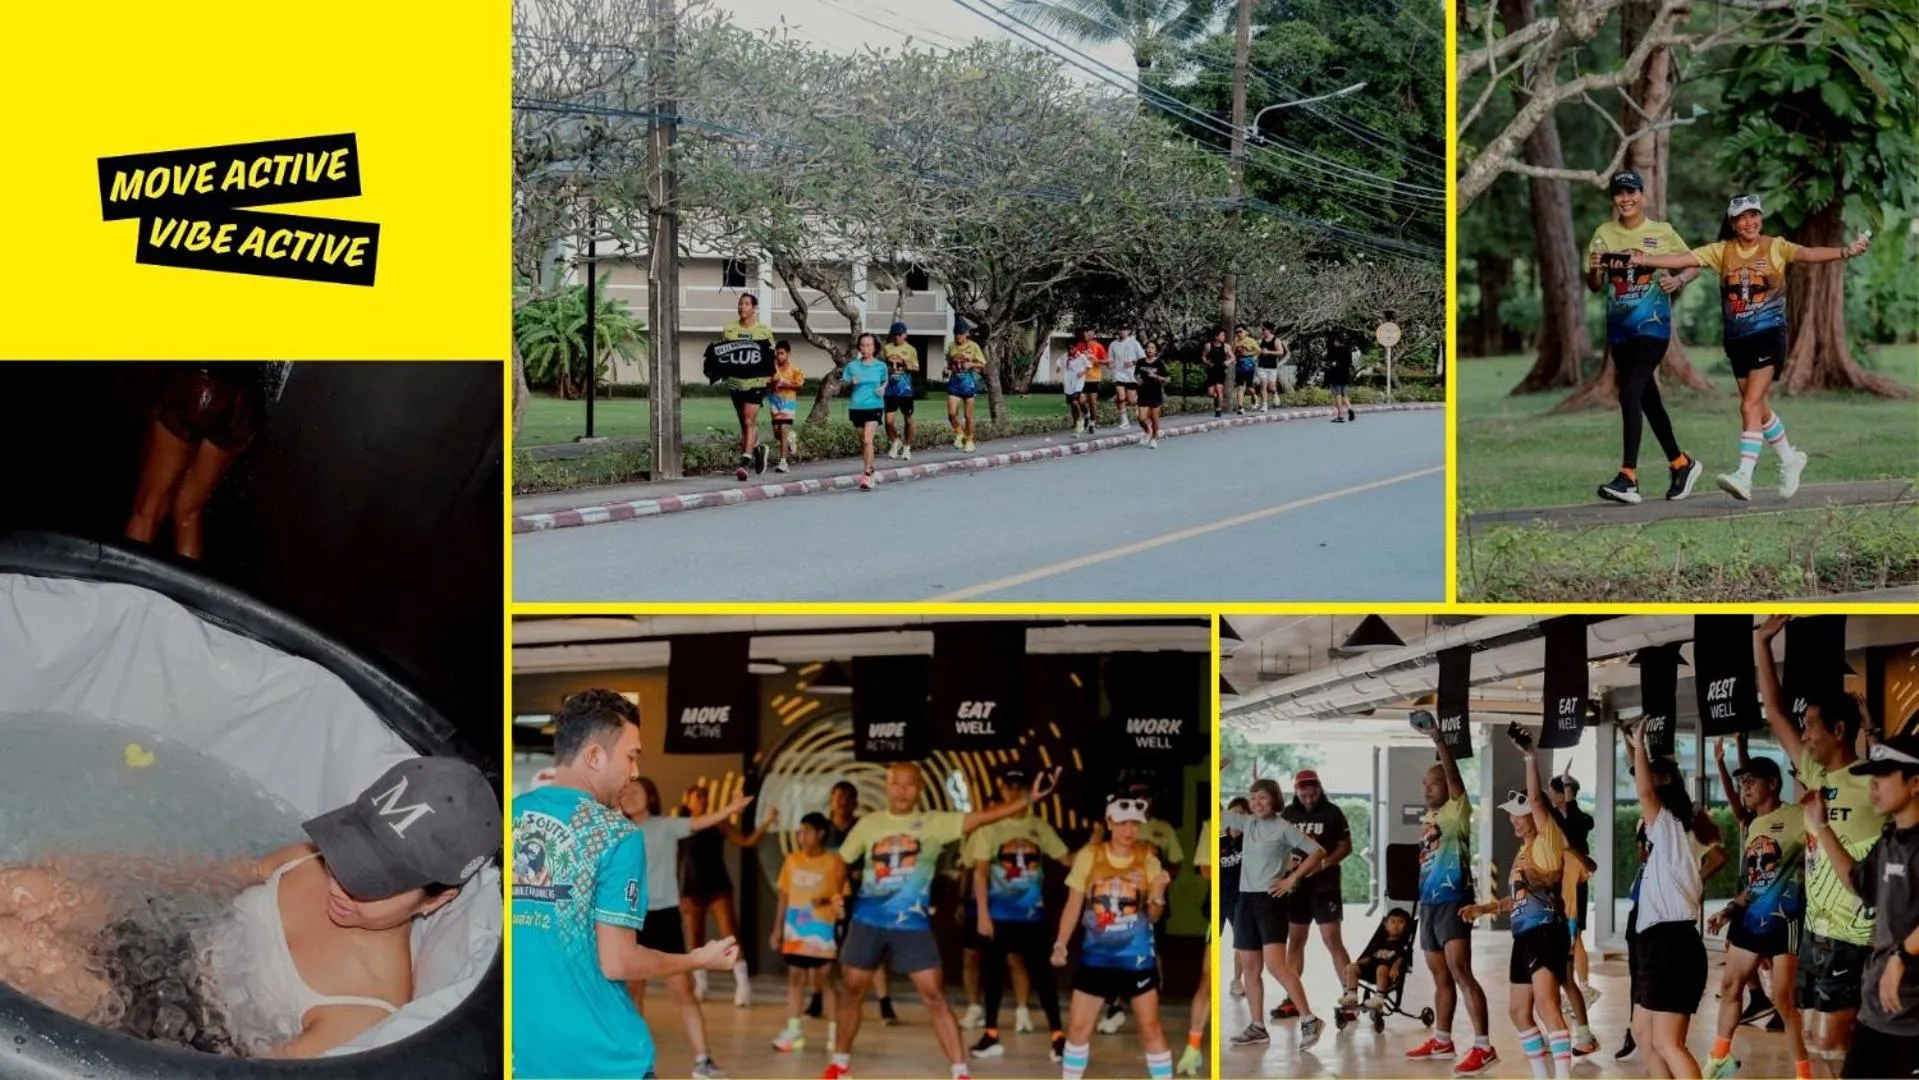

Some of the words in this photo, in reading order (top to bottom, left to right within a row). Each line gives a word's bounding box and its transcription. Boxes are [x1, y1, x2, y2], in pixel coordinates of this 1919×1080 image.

[718, 350, 762, 364] CLUB
[1707, 677, 1737, 701] REST
[681, 705, 731, 724] MOVE
[957, 701, 997, 719] EAT
[1559, 697, 1579, 715] EAT
[1710, 702, 1736, 720] WELL
[683, 724, 722, 739] ACTIVE
[868, 720, 907, 738] VIBE
[955, 720, 996, 735] WELL
[1126, 717, 1183, 736] WORK
[1441, 715, 1462, 733] MOVE
[1558, 717, 1577, 731] WELL
[866, 738, 905, 752] ACTIVE
[1135, 735, 1173, 750] WELL
[371, 775, 436, 839] M
[524, 813, 571, 844] SOUTH
